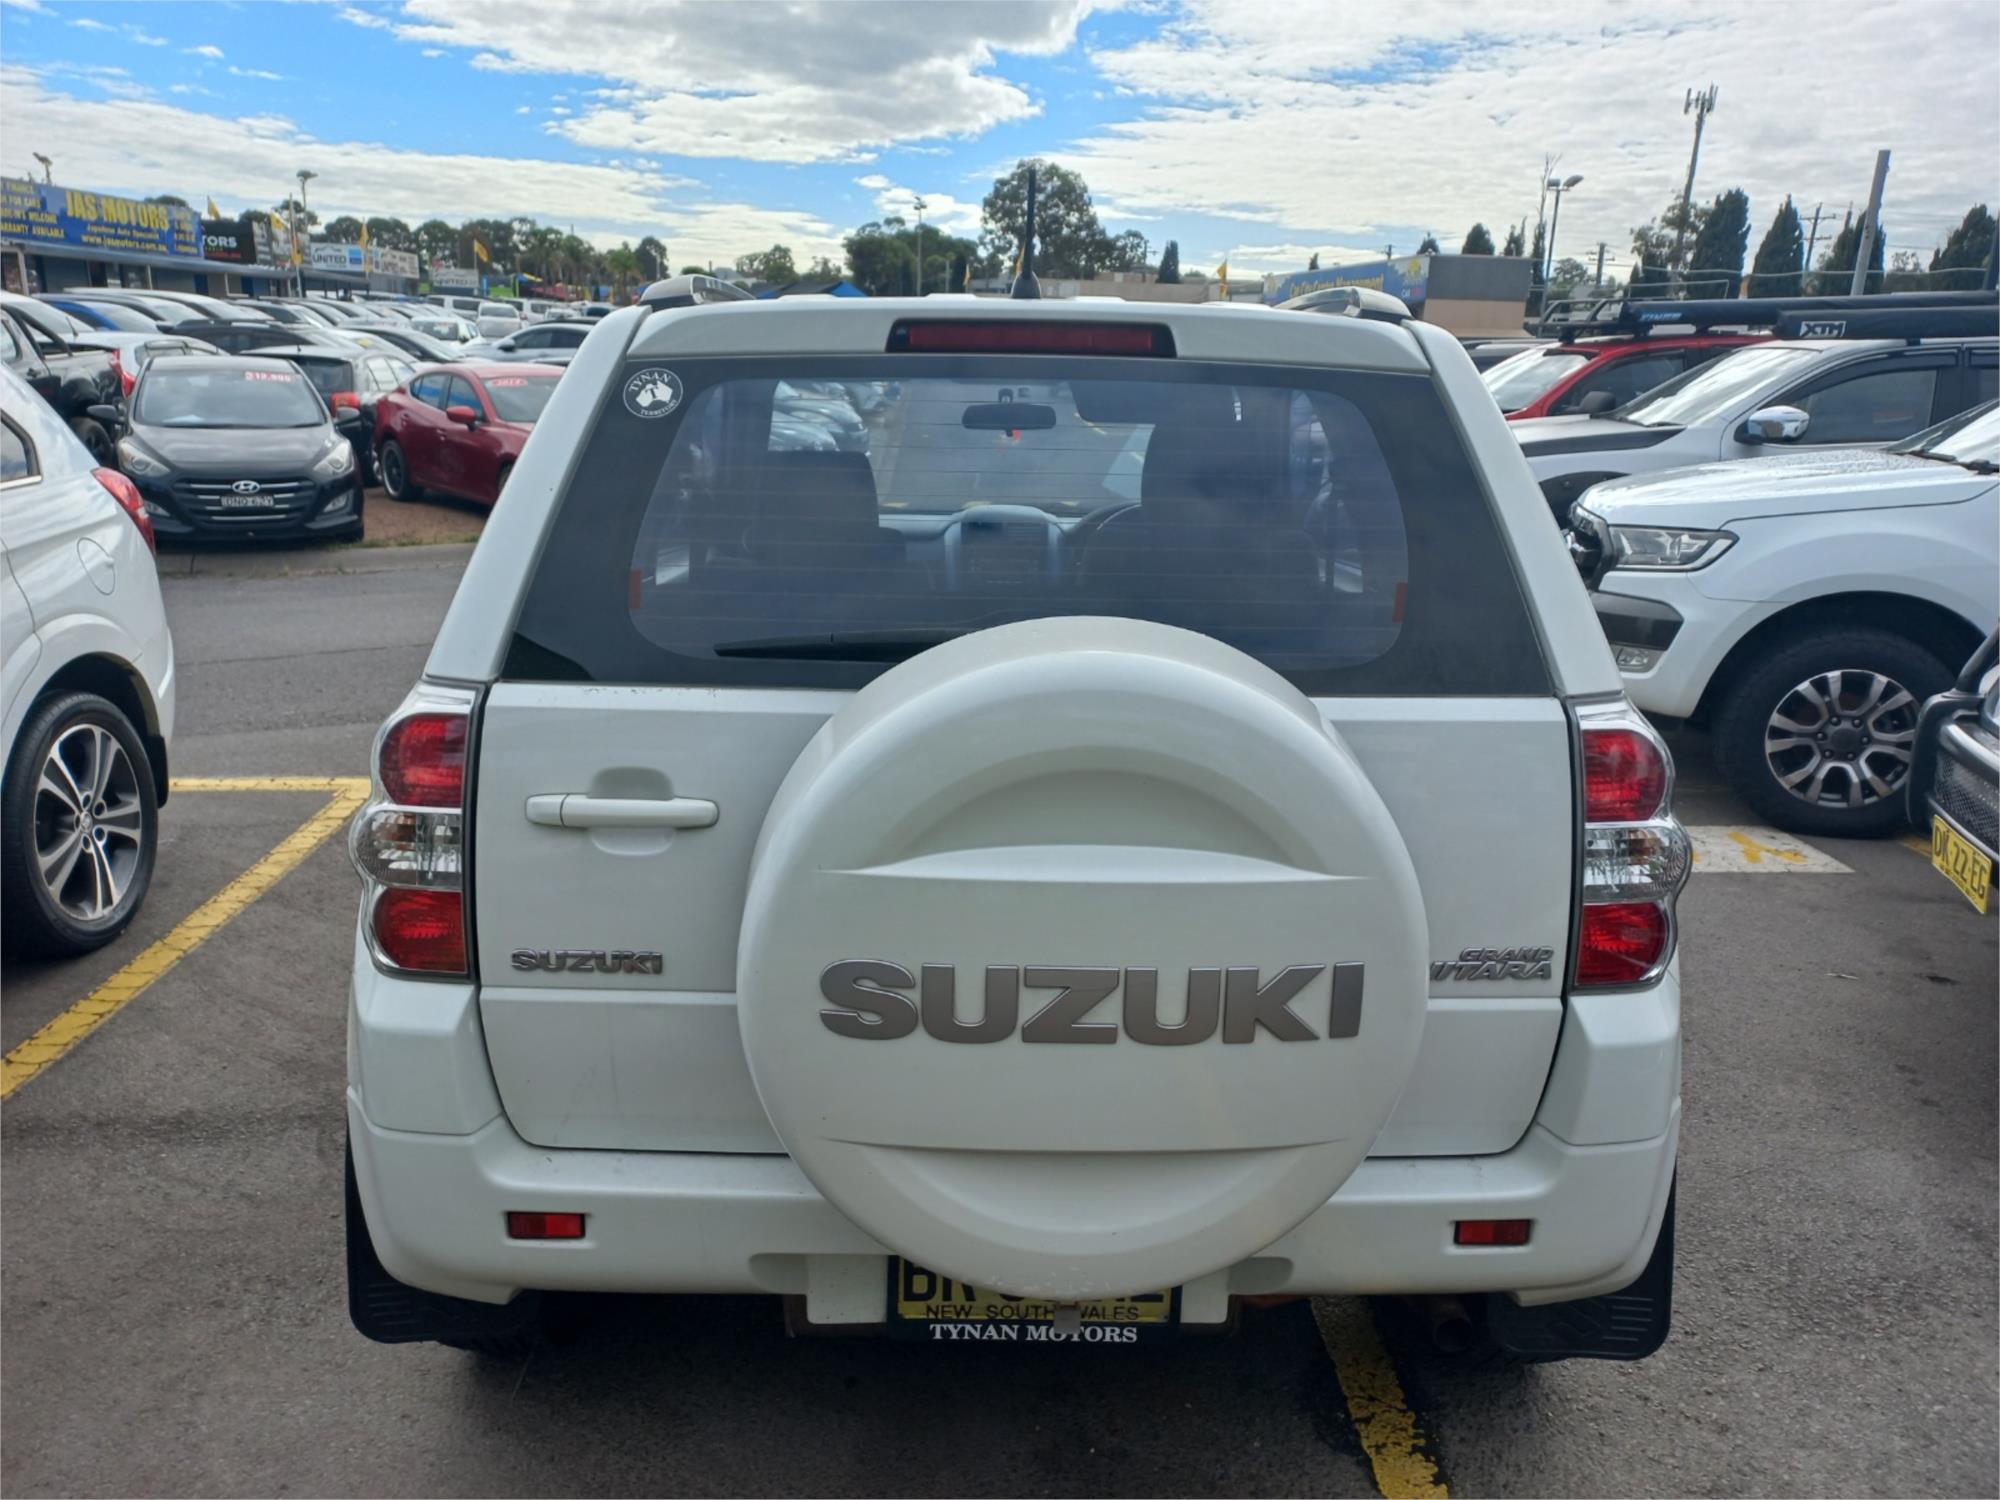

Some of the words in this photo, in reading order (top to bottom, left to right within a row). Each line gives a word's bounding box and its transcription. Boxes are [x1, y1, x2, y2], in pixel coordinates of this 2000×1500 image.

[101, 197, 169, 230] MOTORS
[312, 254, 347, 264] UNITED
[1801, 322, 1845, 338] XTM
[628, 371, 672, 392] TYNAN
[511, 948, 664, 975] SUZUKI
[1459, 946, 1555, 962] GRAND
[819, 958, 1365, 1046] SUZUKI
[926, 1305, 973, 1319] NEW
[929, 1323, 1019, 1341] TYNAN
